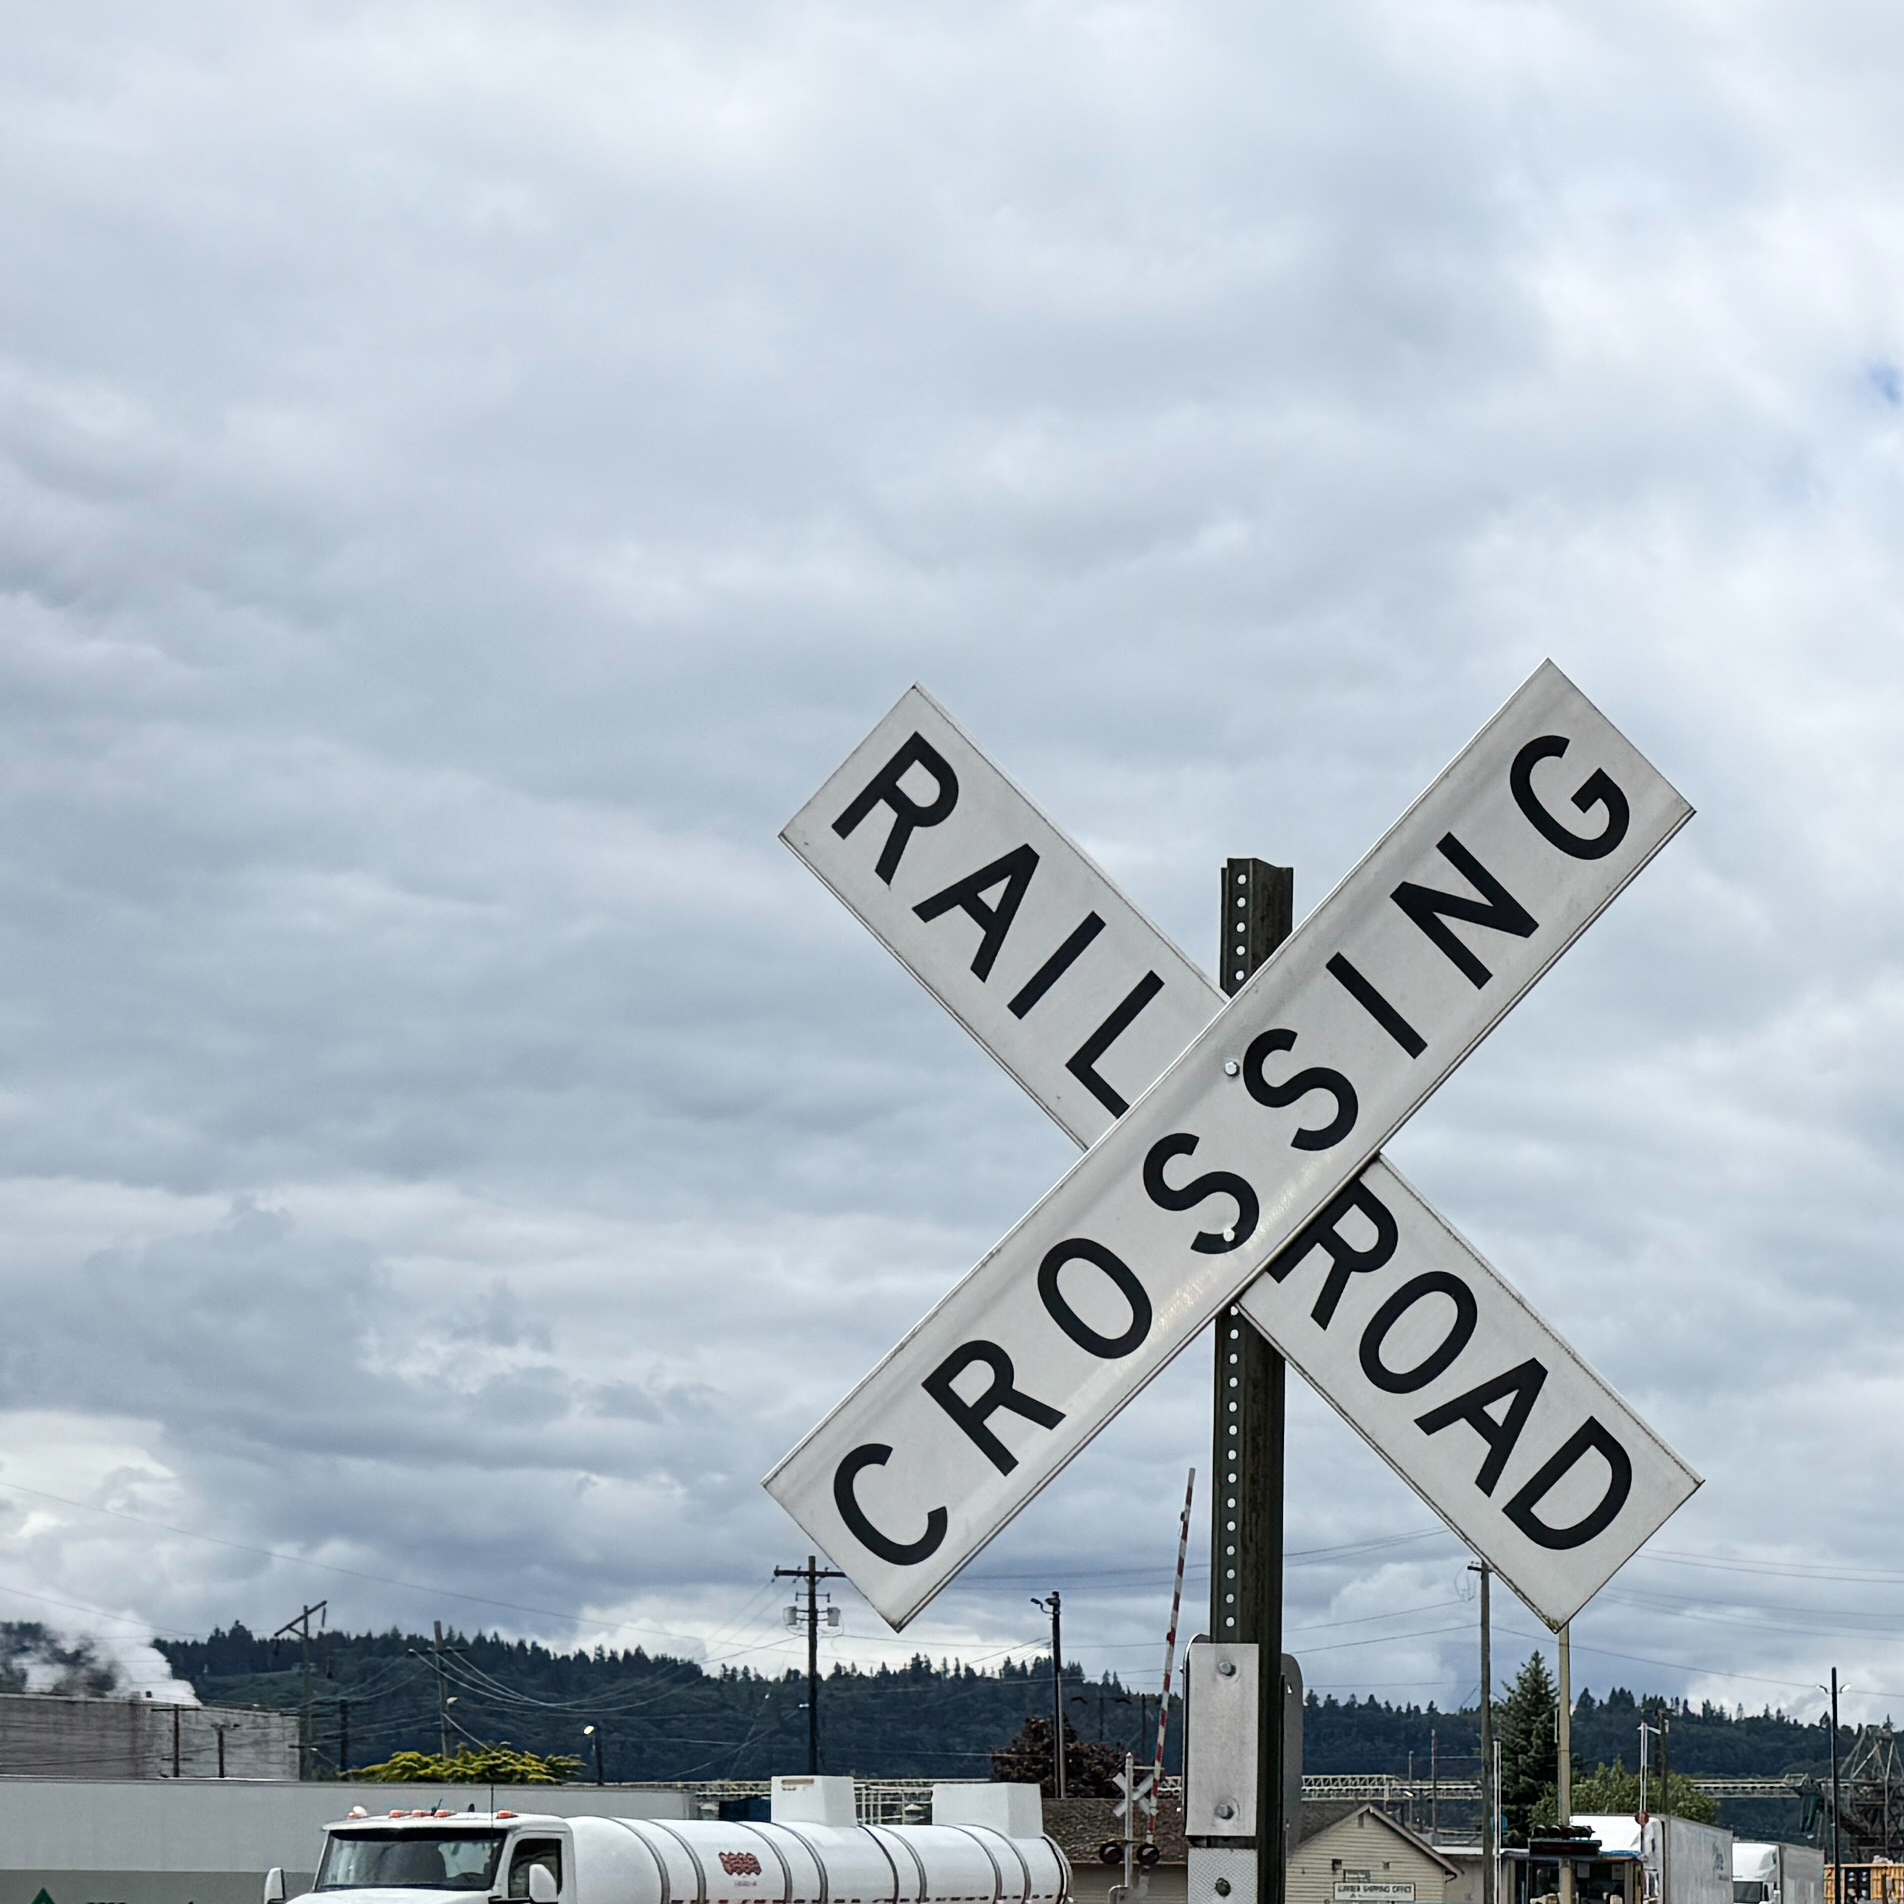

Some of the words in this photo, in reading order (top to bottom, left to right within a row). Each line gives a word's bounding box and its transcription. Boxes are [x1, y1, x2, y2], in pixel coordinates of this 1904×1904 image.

[831, 731, 1166, 1119] RAIL
[1267, 1176, 1634, 1552] ROAD
[831, 733, 1633, 1567] CROSSING
